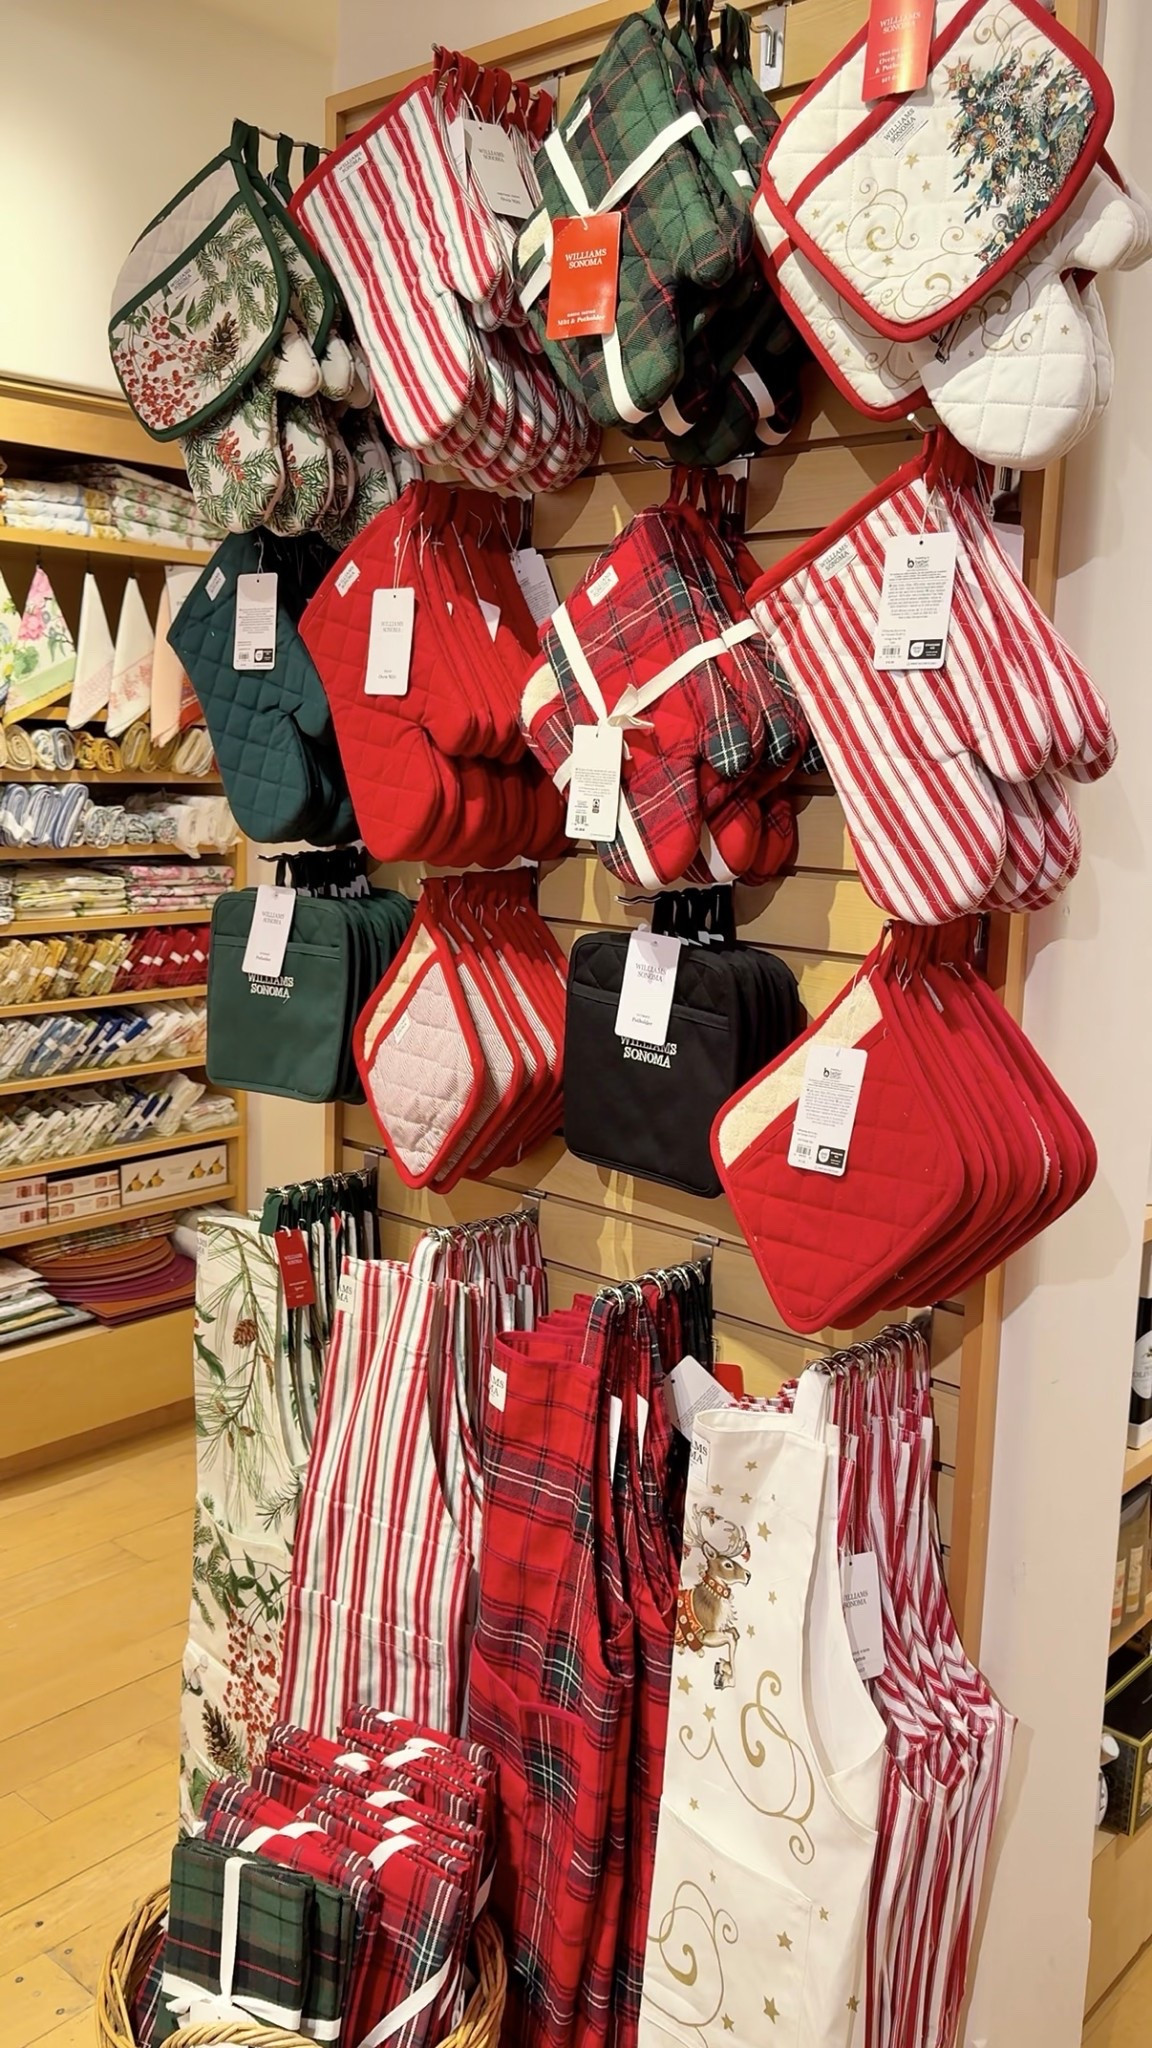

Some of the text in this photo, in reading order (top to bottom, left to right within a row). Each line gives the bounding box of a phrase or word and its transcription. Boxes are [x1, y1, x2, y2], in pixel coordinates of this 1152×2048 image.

[880, 12, 920, 28] WILLIS
[883, 20, 916, 33] SONOA
[884, 108, 915, 140] WILLIAMS
[890, 117, 916, 143] SONOMA
[338, 151, 362, 170] WILLIAMS
[342, 157, 363, 173] SONOMA
[565, 248, 607, 261] WILLIAMS
[568, 258, 603, 269] SONOMA
[819, 543, 849, 568] WILLIAMS
[825, 551, 850, 571] SONOMA
[636, 963, 666, 975] WILLIAMS
[638, 971, 663, 982] SONOMA
[248, 971, 294, 987] WILLIAMS
[250, 983, 290, 998] SONOMA
[624, 1047, 671, 1068] SONOMA
